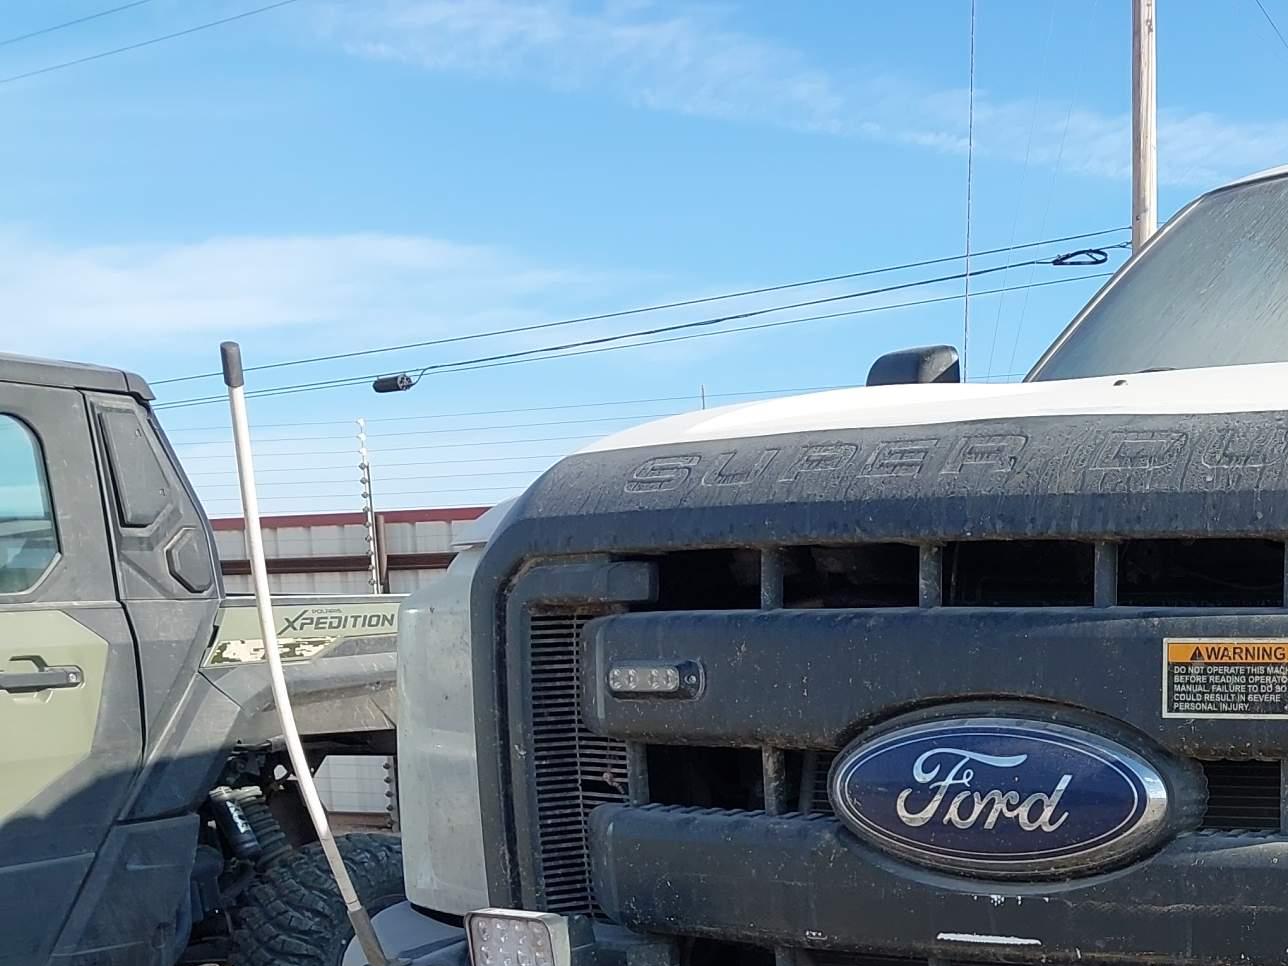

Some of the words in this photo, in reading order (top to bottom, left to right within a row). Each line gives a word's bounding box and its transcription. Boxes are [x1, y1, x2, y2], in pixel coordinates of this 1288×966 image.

[624, 434, 1031, 494] SUPER
[277, 609, 395, 636] XPEDITION
[1204, 646, 1286, 661] WARNING
[1173, 666, 1187, 674] DO
[1188, 666, 1205, 675] NOT
[1207, 666, 1245, 675] OPERATE
[1246, 667, 1265, 675] THIS
[1173, 675, 1207, 684] BEFORE
[1209, 675, 1246, 684] READING
[1211, 684, 1246, 693] FAILURE
[1248, 685, 1259, 693] TO
[1260, 684, 1273, 693] DO
[1275, 684, 1288, 693] SO
[1173, 693, 1202, 702] COULD
[1204, 693, 1235, 702] RESULT
[1237, 693, 1246, 702] IN
[1248, 694, 1281, 702] SEVERE
[1173, 702, 1218, 711] PERSONAL
[896, 747, 1070, 833] Ford
